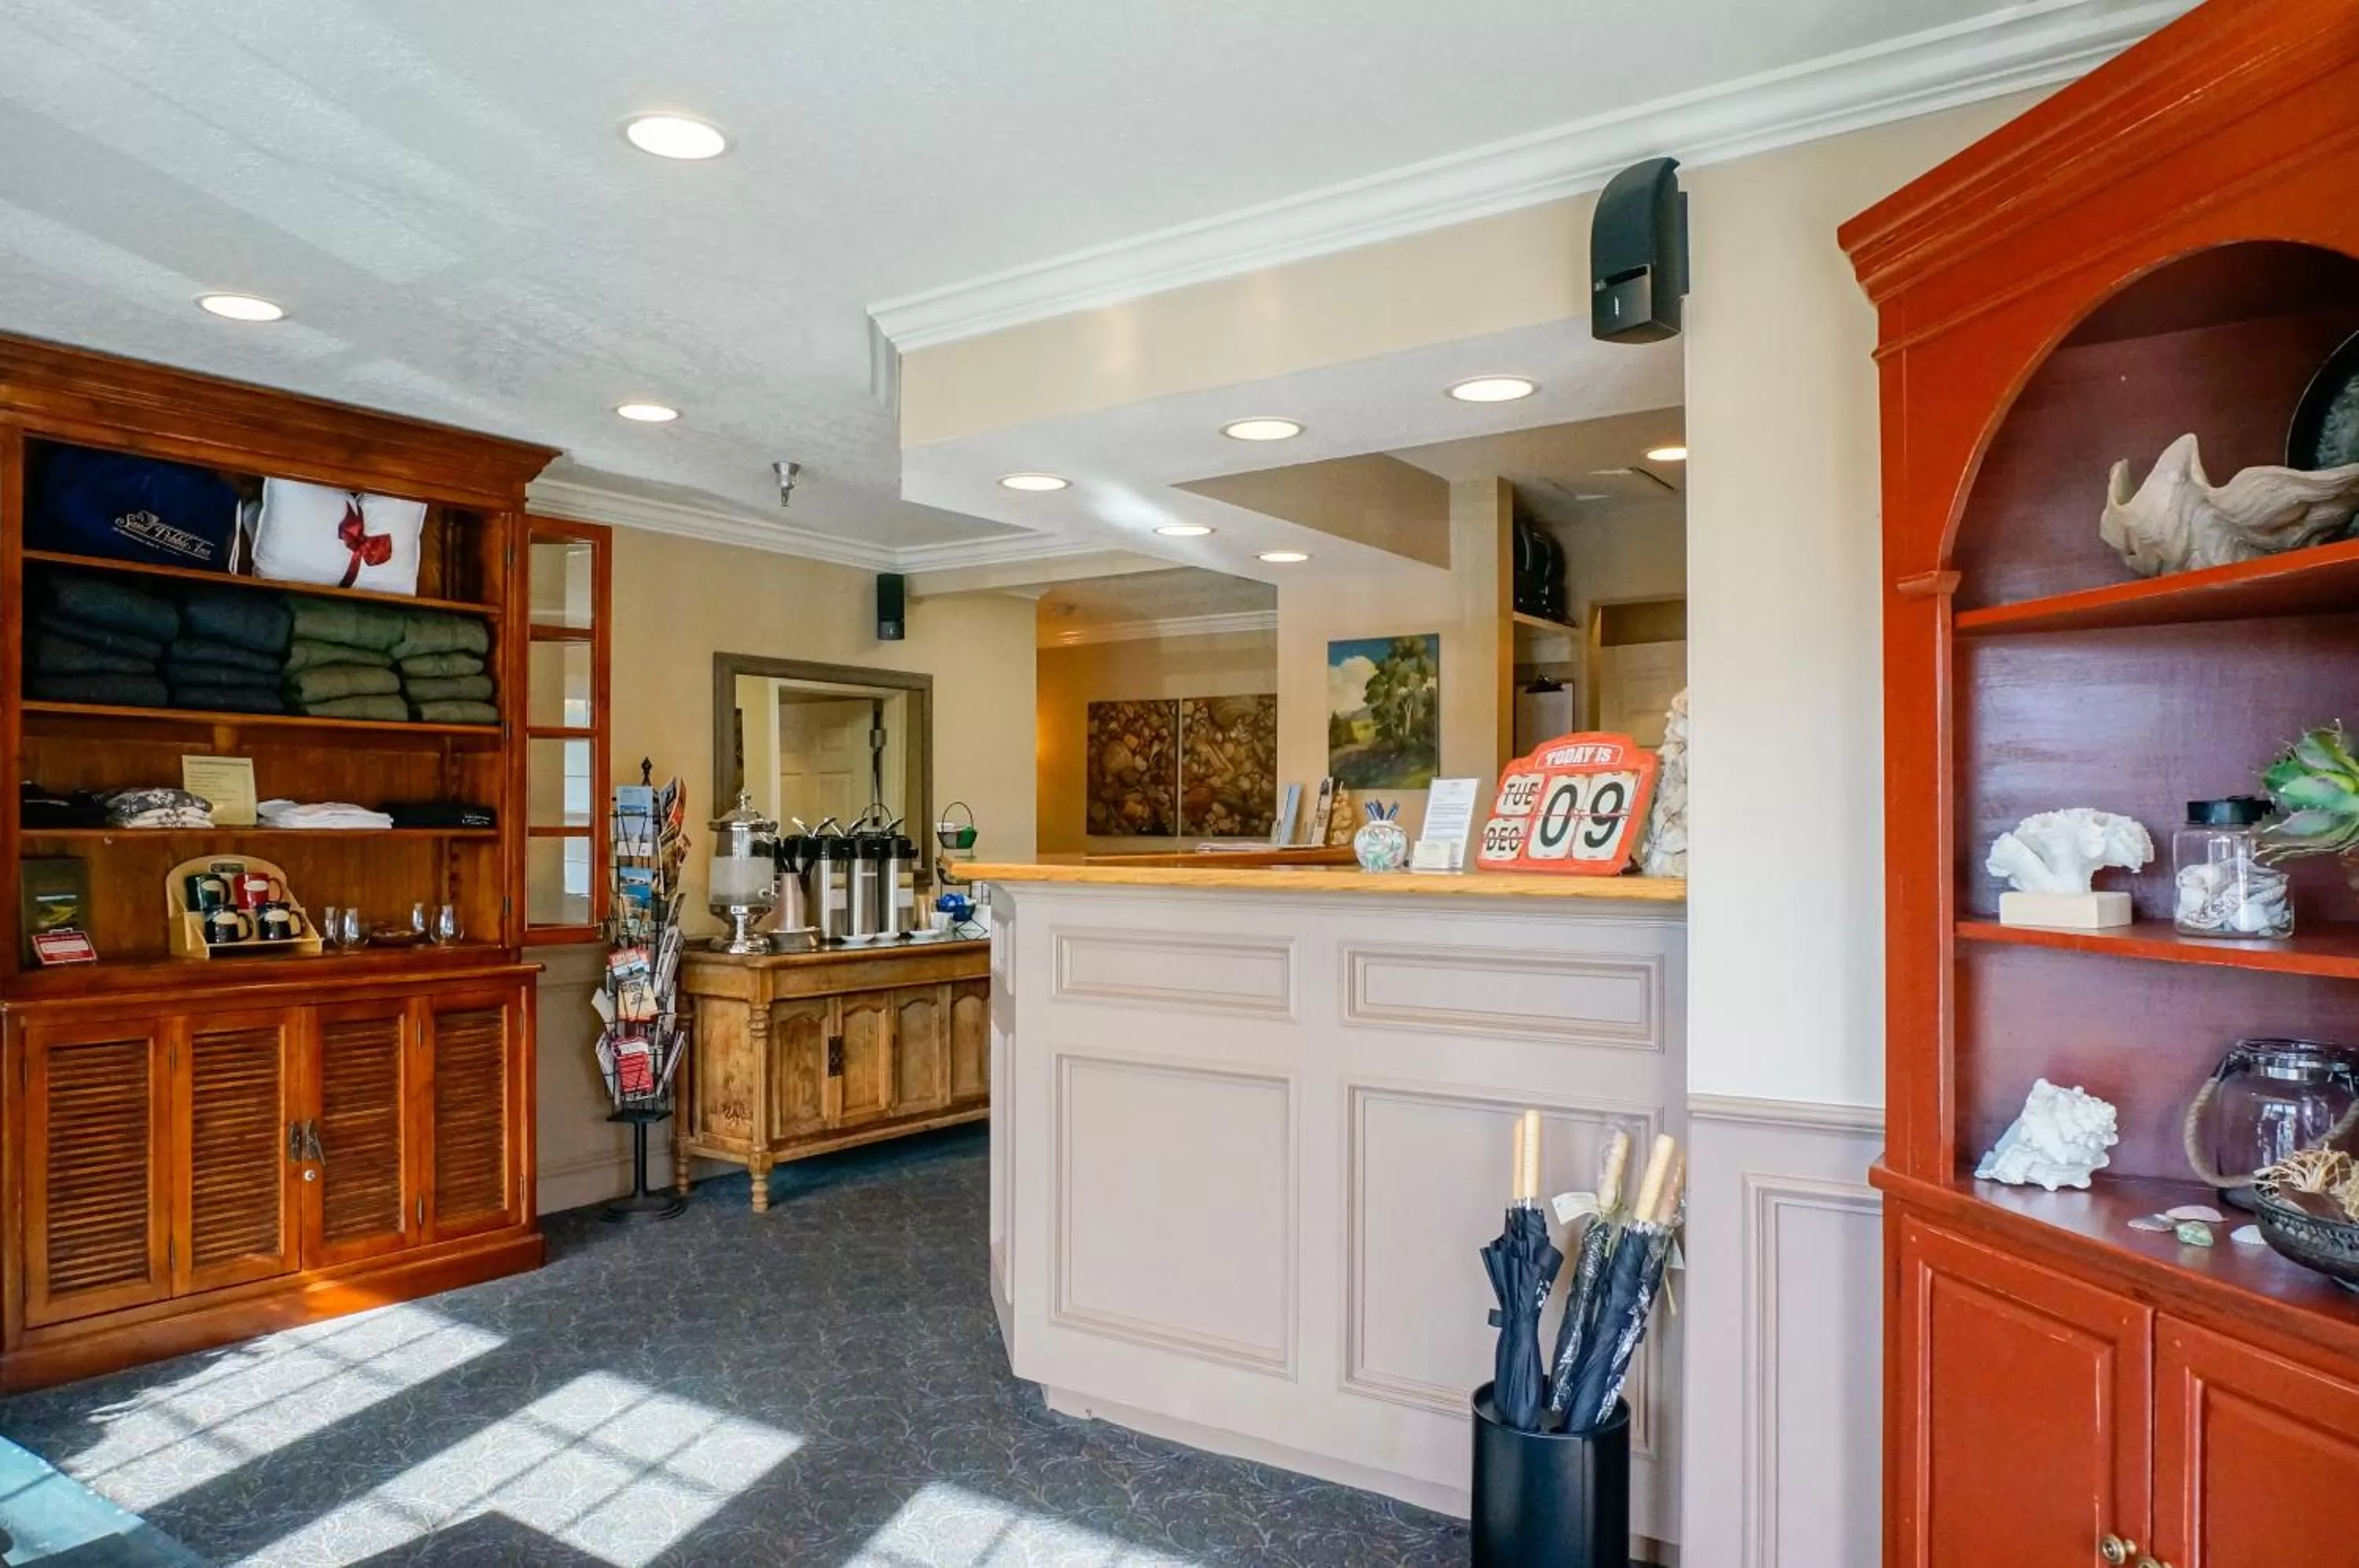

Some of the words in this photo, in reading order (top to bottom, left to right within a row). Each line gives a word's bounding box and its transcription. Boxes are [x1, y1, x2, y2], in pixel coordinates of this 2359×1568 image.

[1546, 746, 1595, 765] TODAY
[1594, 746, 1613, 762] IS
[1503, 782, 1540, 806] TUE
[1539, 781, 1626, 849] 09
[1485, 826, 1521, 852] DEC
